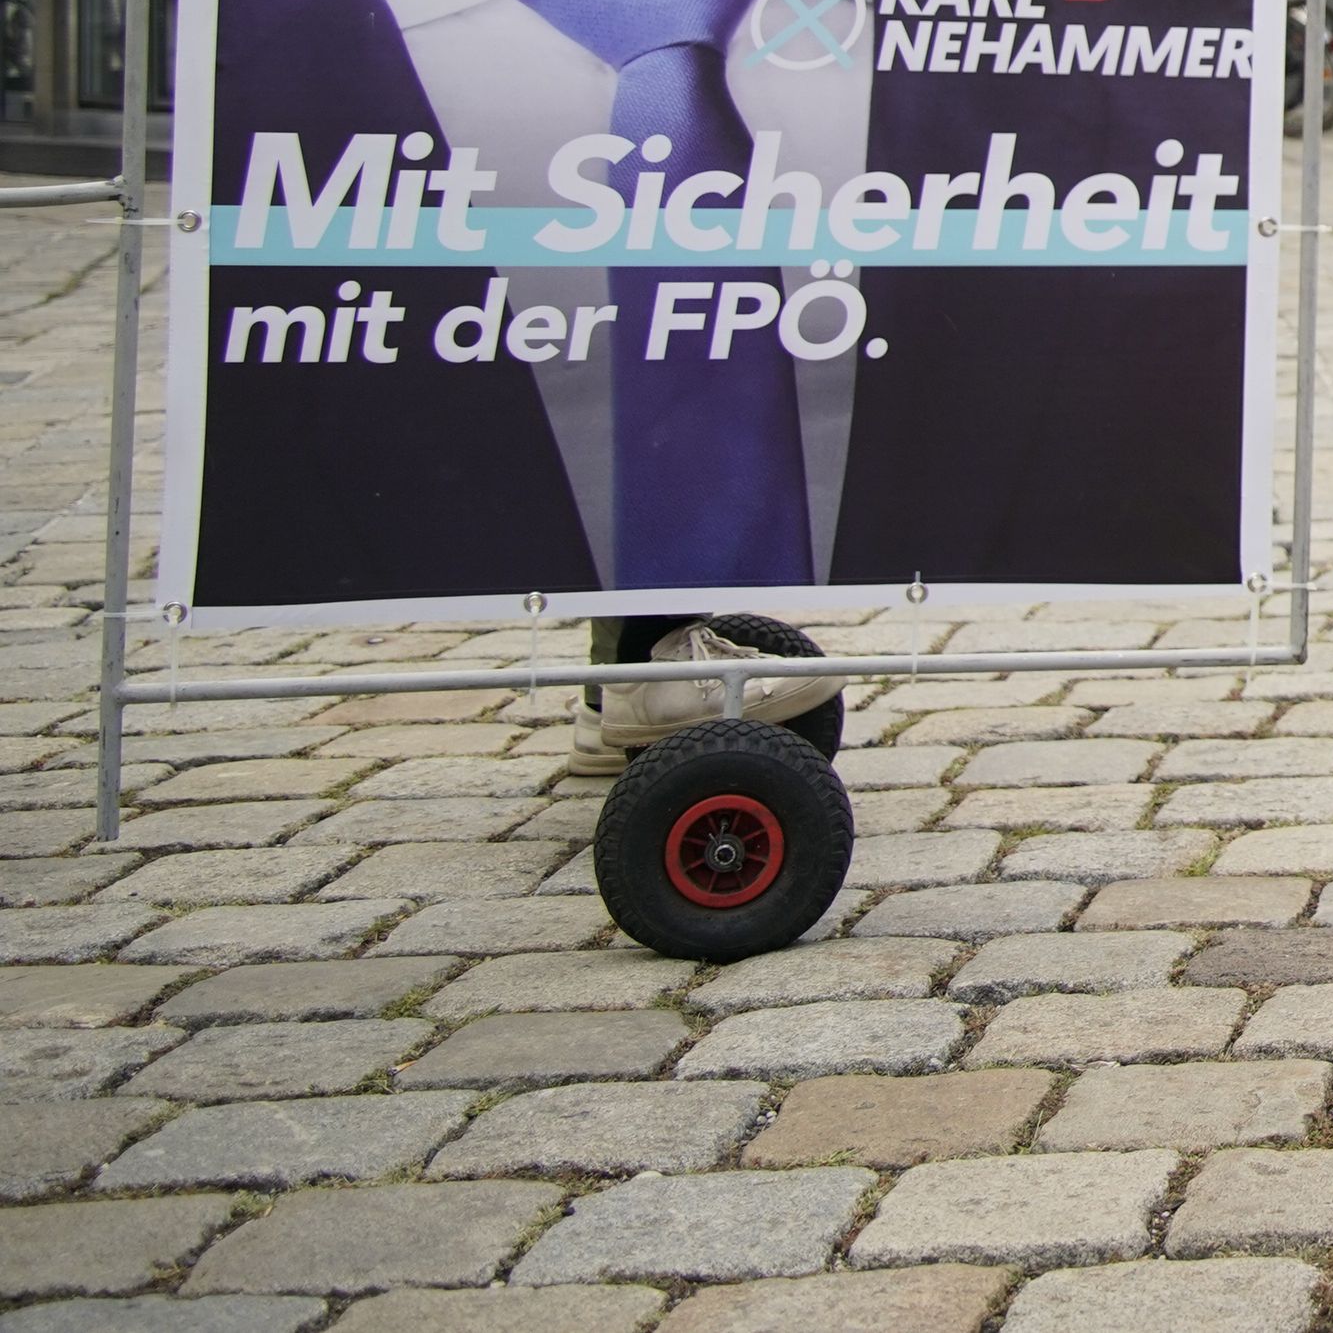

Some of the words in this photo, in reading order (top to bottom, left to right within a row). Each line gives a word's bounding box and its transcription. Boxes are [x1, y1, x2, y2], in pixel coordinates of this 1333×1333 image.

[876, 20, 1253, 79] NEHAMMER
[233, 130, 496, 250] Mit
[532, 130, 1242, 254] Sicherheit
[224, 280, 405, 363] mit
[433, 277, 618, 363] der
[645, 259, 888, 361] FPÖ.
